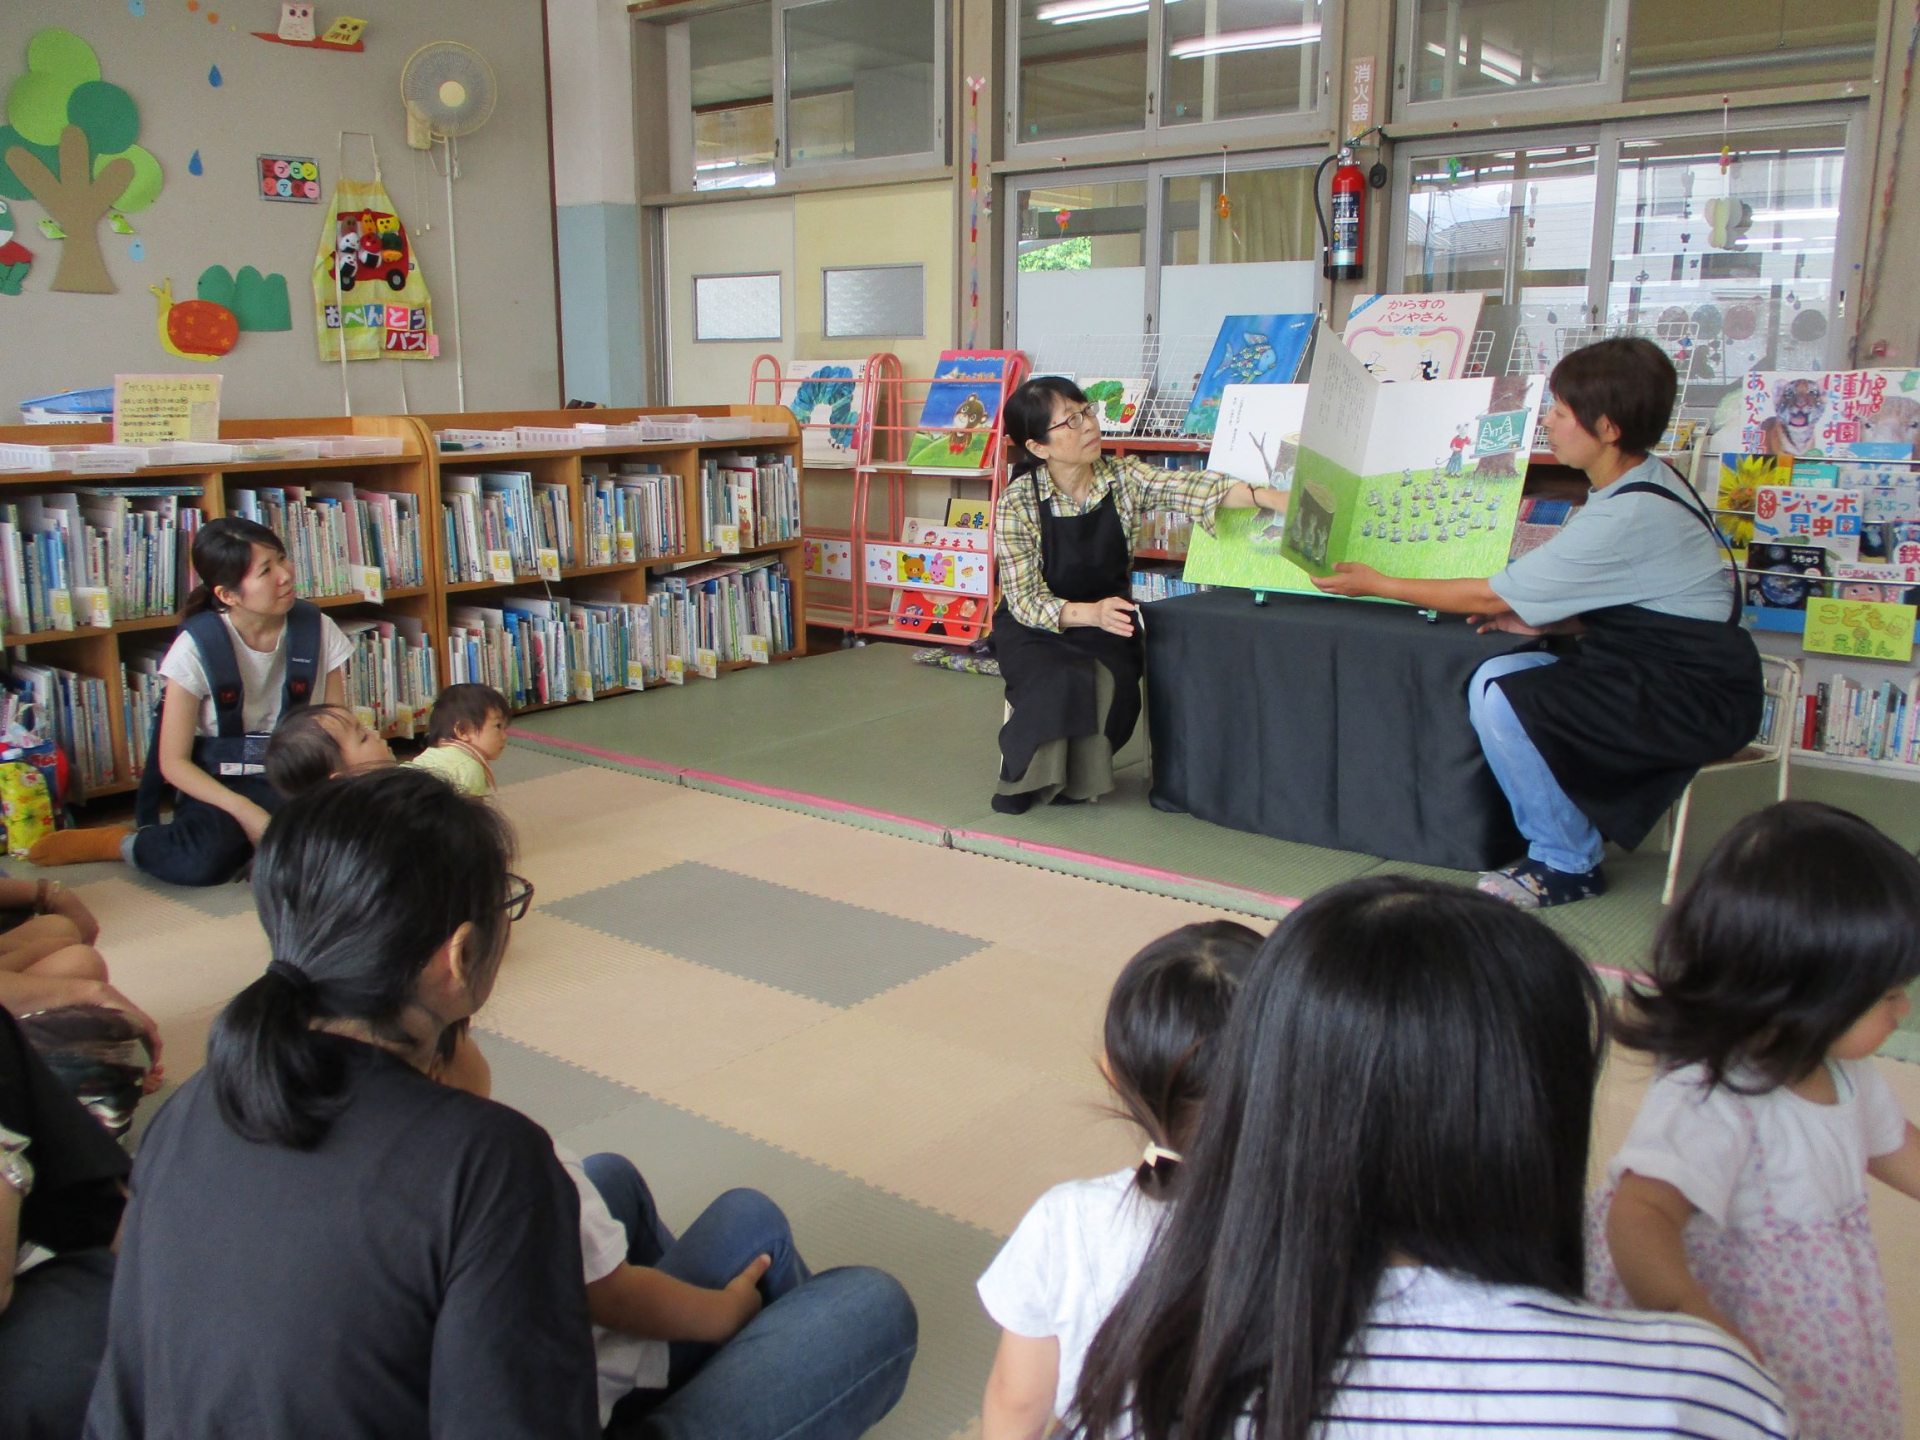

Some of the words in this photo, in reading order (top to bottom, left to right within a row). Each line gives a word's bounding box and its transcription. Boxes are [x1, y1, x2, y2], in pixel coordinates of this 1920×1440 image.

[1352, 64, 1371, 122] 消火器
[1387, 298, 1445, 310] からすの
[325, 305, 426, 330] おべんとう
[1378, 311, 1448, 323] パンやさん
[386, 331, 426, 350] バス
[1781, 490, 1860, 514] ジャンボ
[1791, 554, 1820, 565] うちゅう
[1819, 604, 1886, 630] こども
[1832, 633, 1895, 657] えほん
